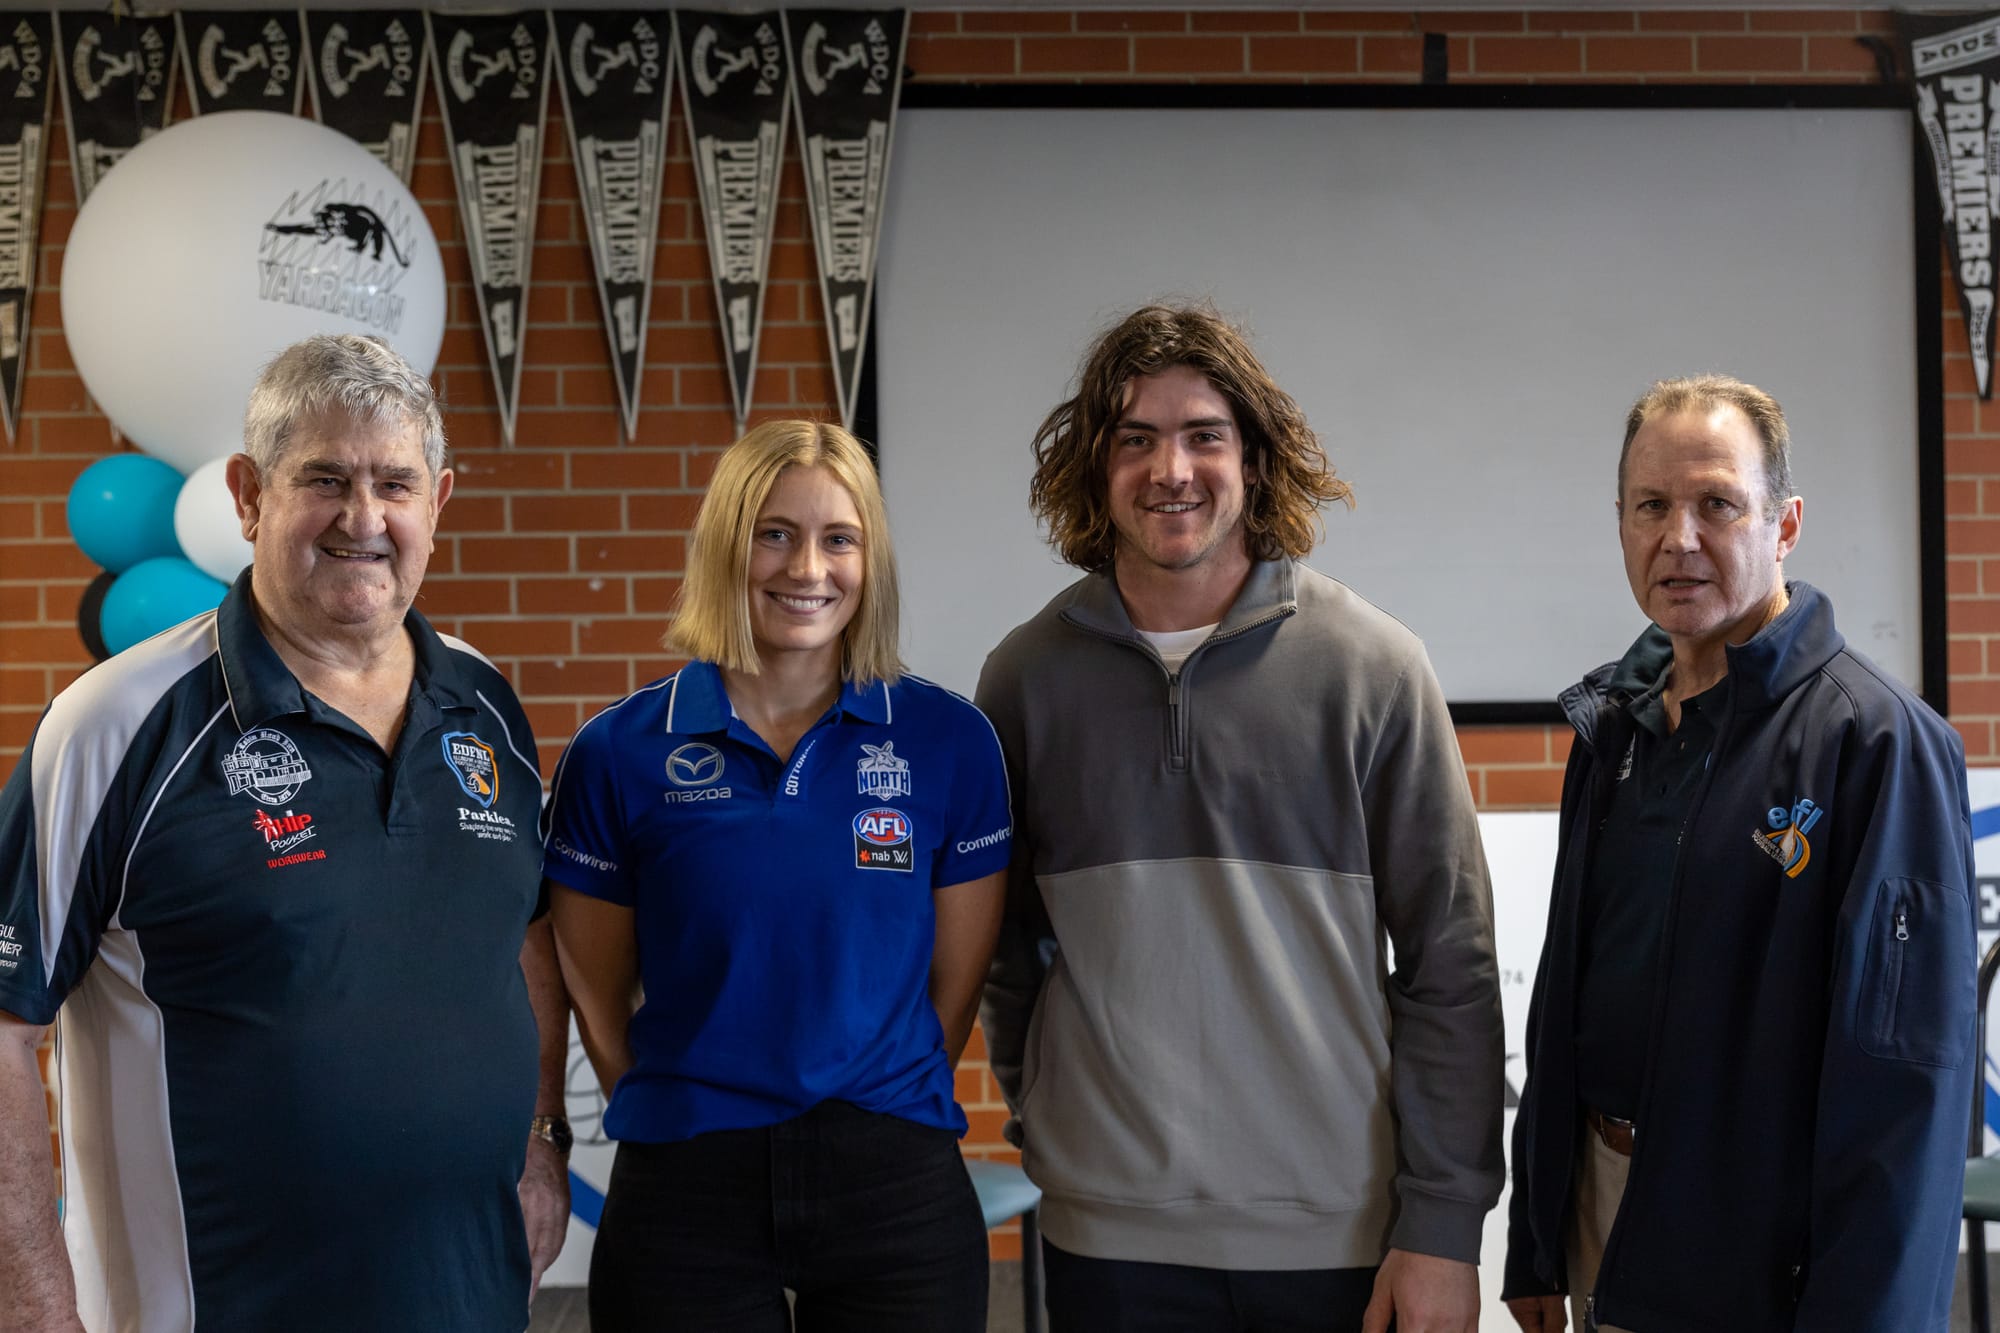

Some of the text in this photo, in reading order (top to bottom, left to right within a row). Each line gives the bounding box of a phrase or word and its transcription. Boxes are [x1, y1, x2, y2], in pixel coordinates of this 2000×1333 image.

[1940, 73, 1992, 289] PREMIERS
[472, 142, 519, 289] PREMIERS
[593, 138, 641, 284] PREMIERS
[713, 138, 760, 283] PREMIERS
[823, 138, 870, 283] PREMIERS
[785, 754, 807, 796] COTTON
[858, 771, 910, 796] NORTH
[270, 826, 317, 852] POCKET
[860, 816, 907, 836] AFL
[267, 850, 327, 869] WORKWEAR
[871, 851, 890, 862] nab
